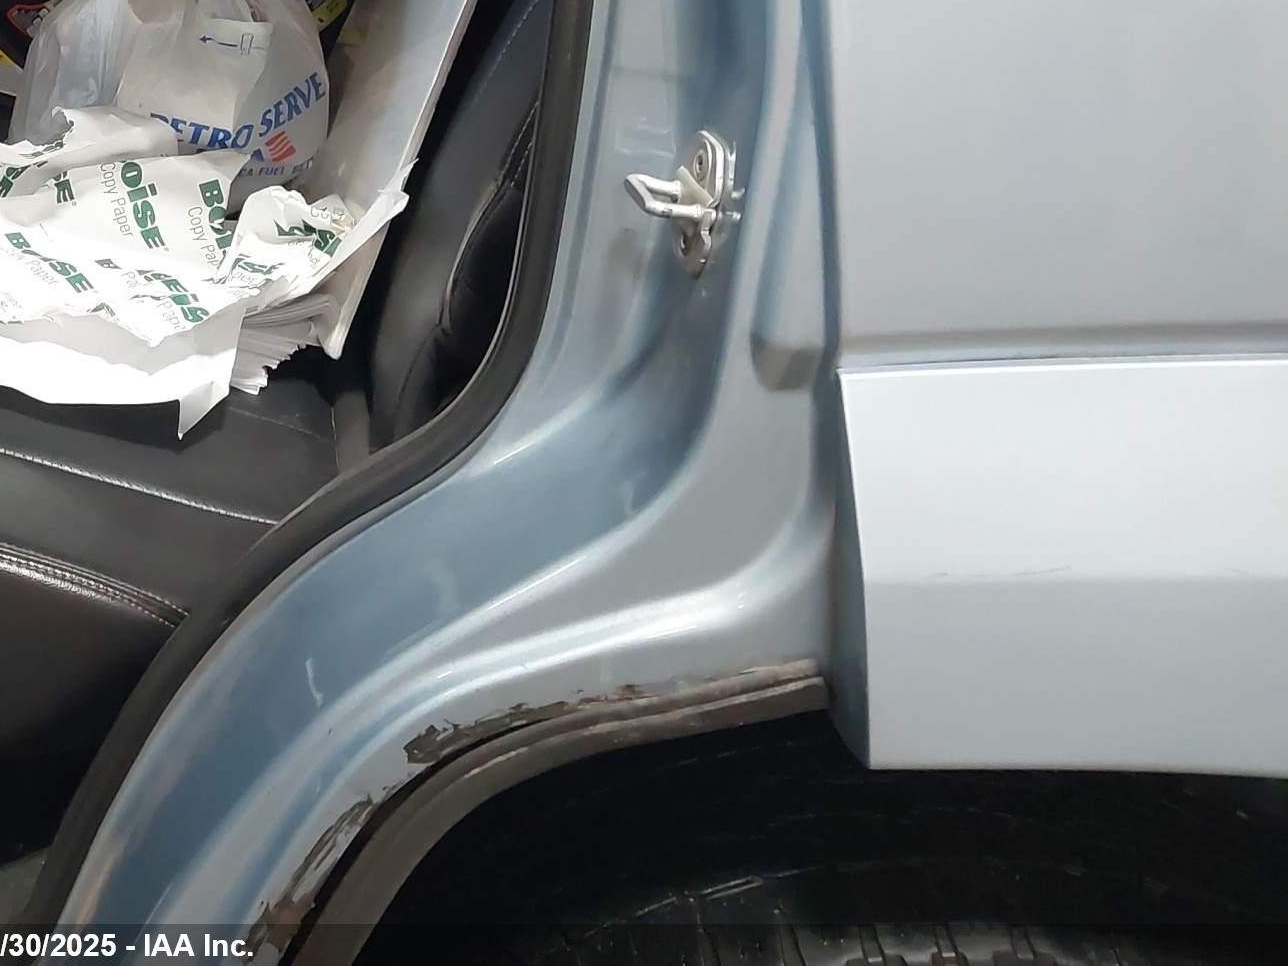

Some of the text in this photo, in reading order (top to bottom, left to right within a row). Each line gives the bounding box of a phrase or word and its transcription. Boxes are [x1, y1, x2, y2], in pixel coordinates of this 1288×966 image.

[258, 71, 326, 137] SERVE
[100, 162, 133, 238] Copy Paper
[187, 206, 208, 242] Copy
[26, 259, 58, 286] Paper
